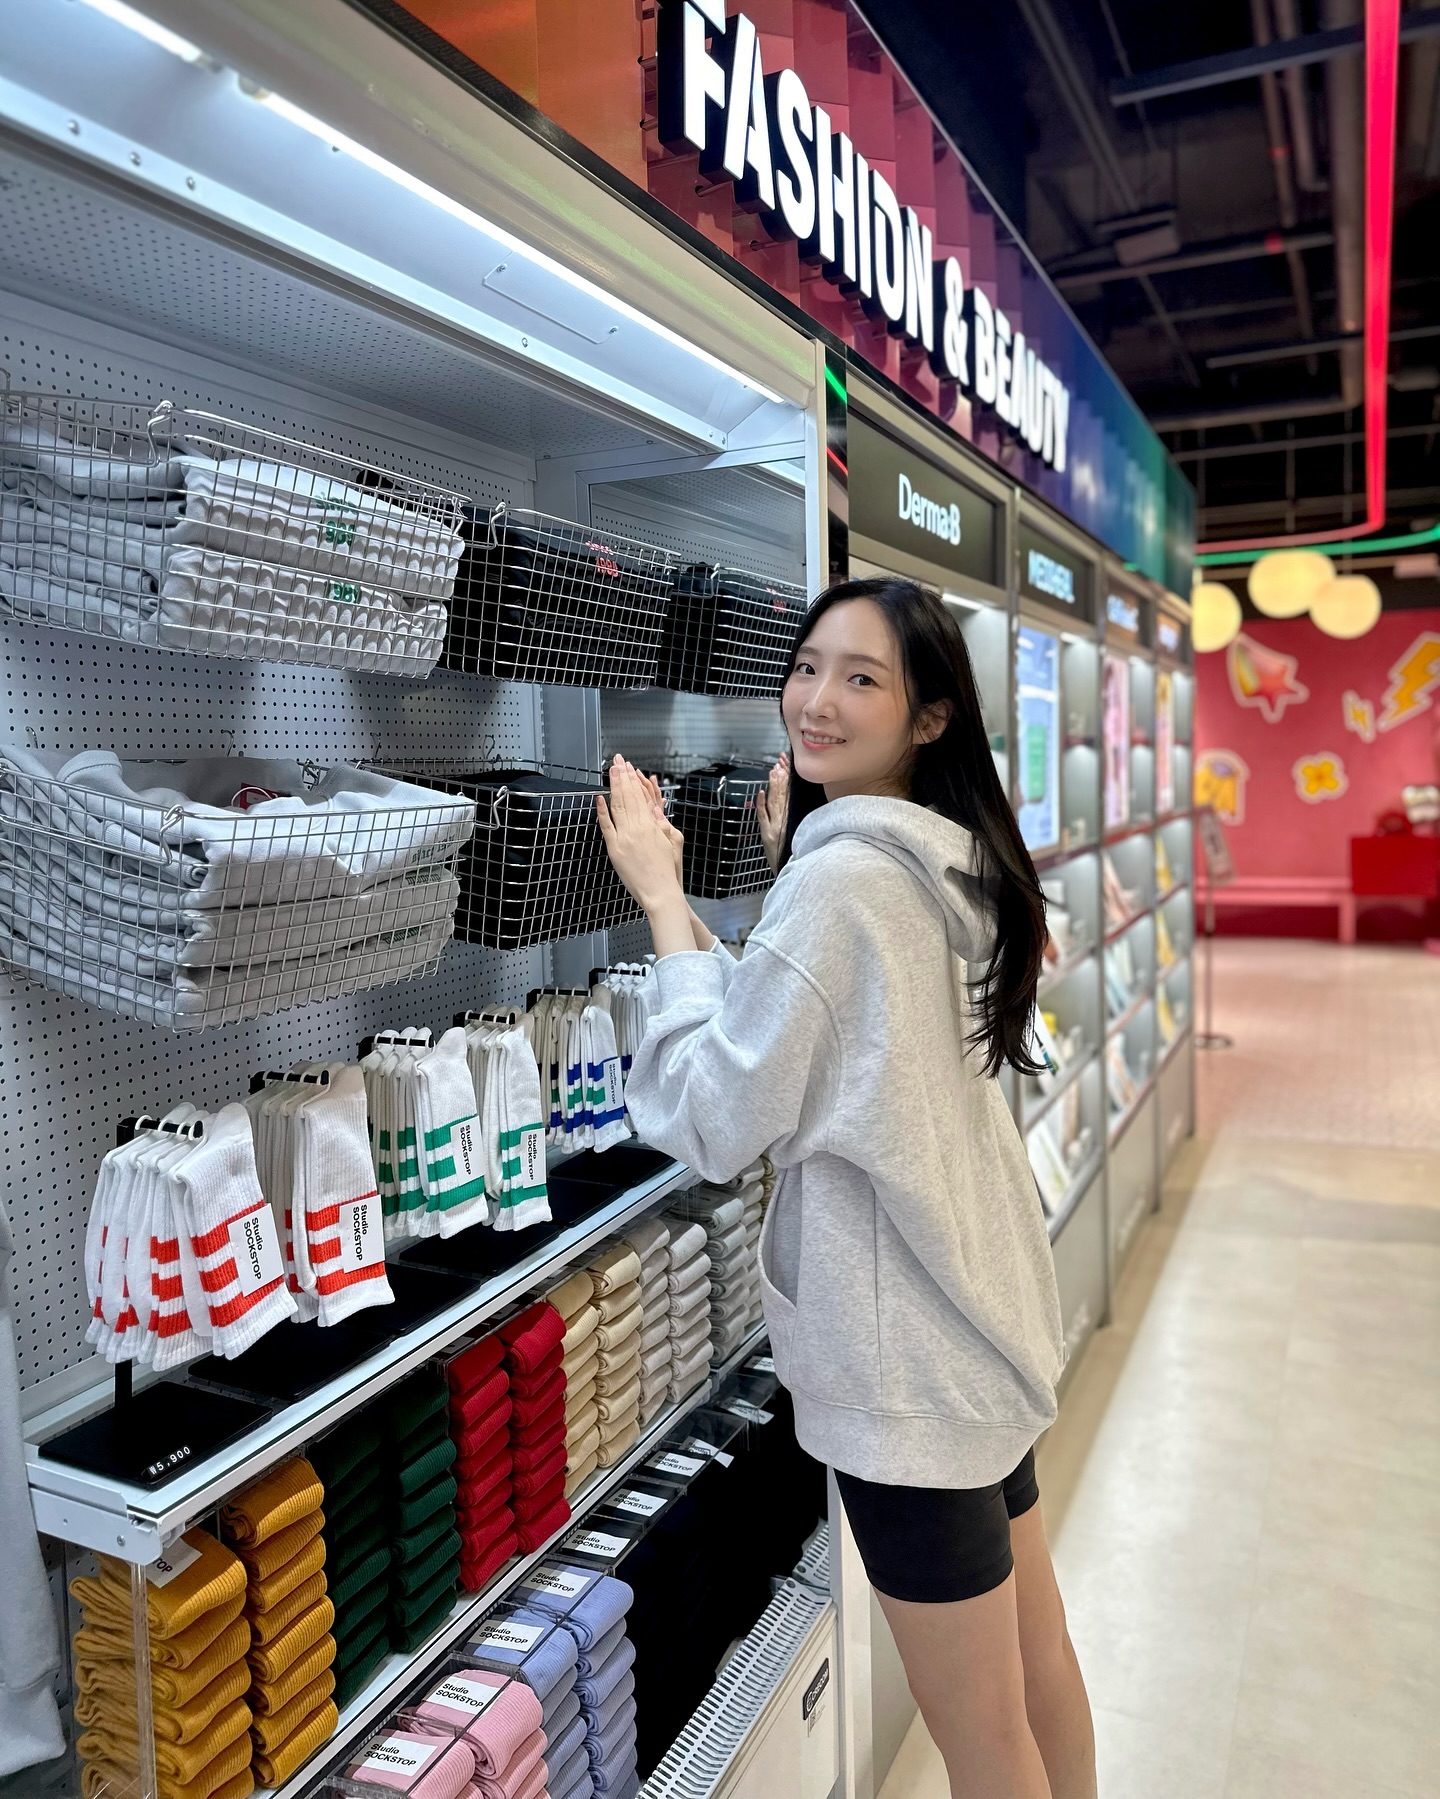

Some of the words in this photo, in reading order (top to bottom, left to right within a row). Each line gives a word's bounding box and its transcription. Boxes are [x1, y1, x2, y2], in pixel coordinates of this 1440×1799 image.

[683, 0, 933, 352] FASHION
[943, 256, 969, 386] &
[974, 286, 1069, 473] BEAUTY
[465, 1124, 473, 1152] Studio
[460, 1126, 472, 1175] SOCKSTOP
[360, 1204, 369, 1235] Studio
[251, 1217, 263, 1251] Studio
[352, 1206, 363, 1261] SOCKSTOP
[243, 1221, 262, 1280] SOCKSTOP
[653, 1459, 693, 1472] SOCKSTOP
[613, 1497, 653, 1511] SOCKSTOP
[618, 1493, 640, 1502] Studio
[571, 1539, 616, 1552] SOCKSTOP
[575, 1534, 601, 1543] Studio
[535, 1572, 561, 1582] Studio
[530, 1577, 575, 1592] SOCKSTOP
[479, 1631, 529, 1644] SOCKSTOP
[484, 1626, 511, 1635] Studio
[442, 1683, 470, 1695] Studio
[435, 1689, 484, 1708] SOCKSTOP
[370, 1743, 400, 1755] Studio
[363, 1750, 417, 1766] SOCKSTOP
